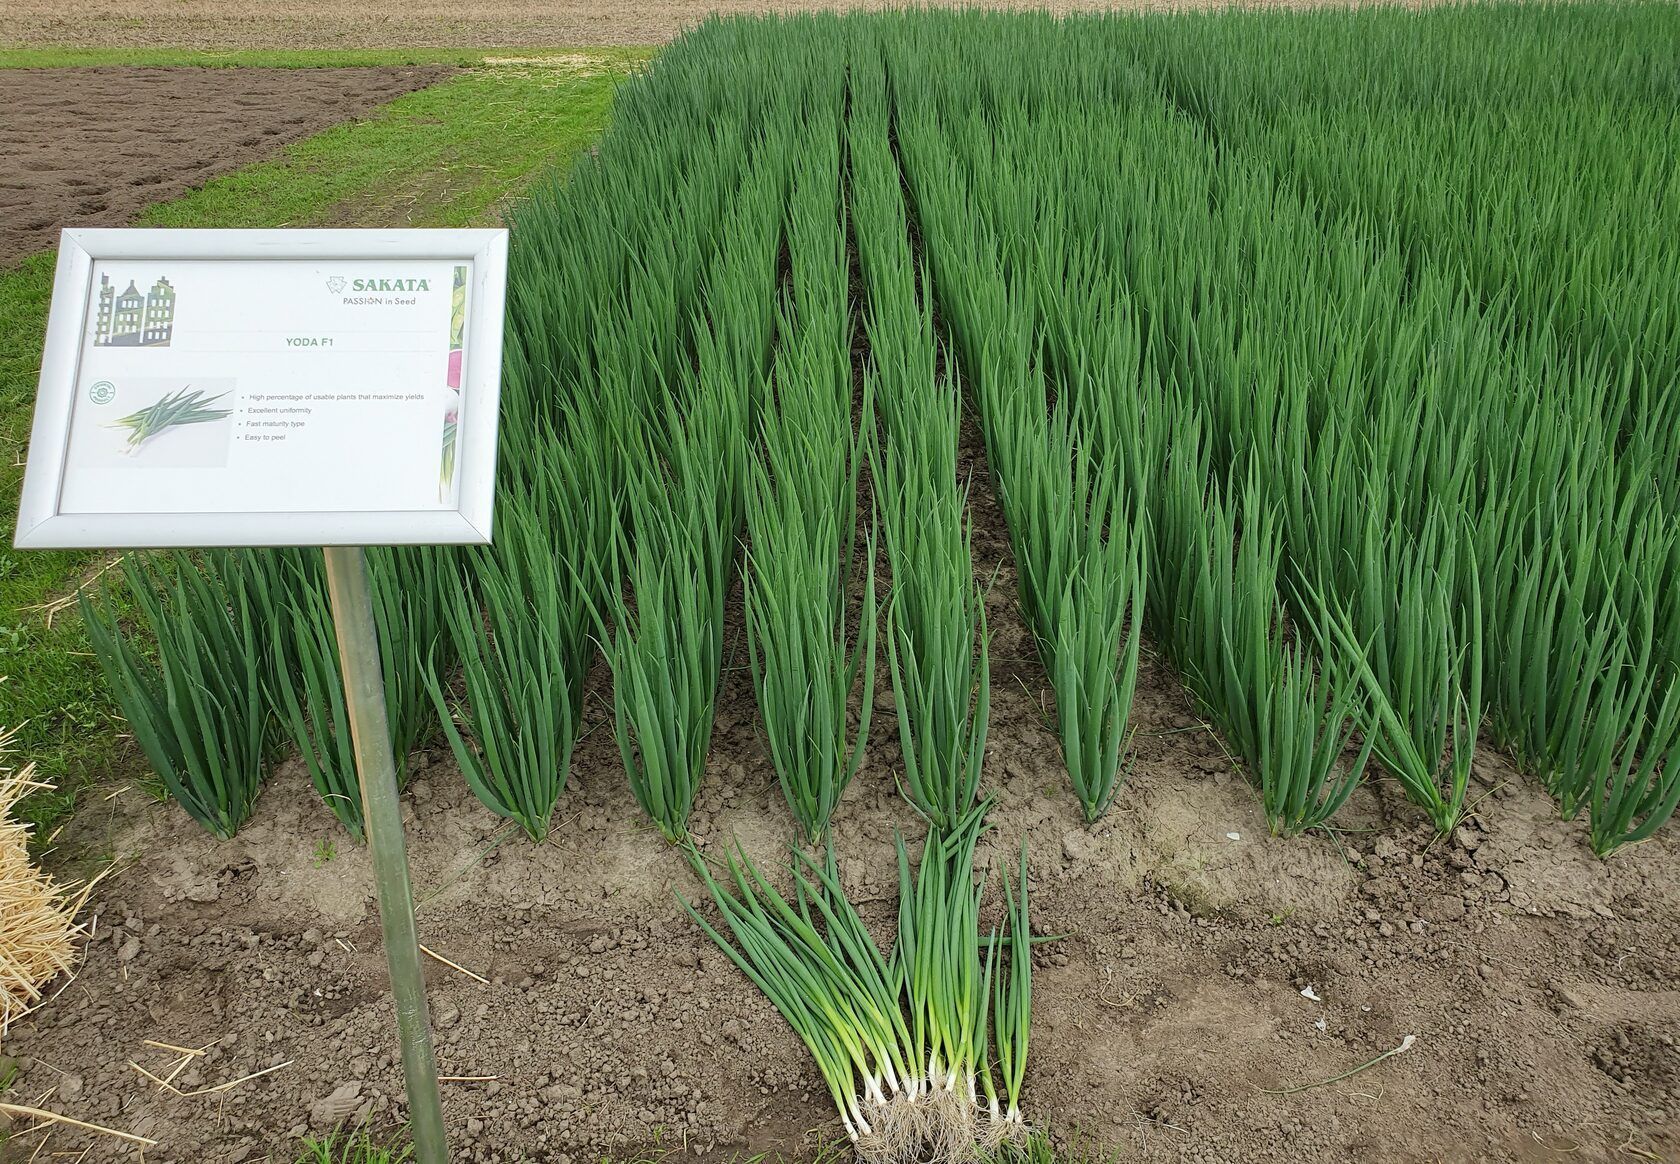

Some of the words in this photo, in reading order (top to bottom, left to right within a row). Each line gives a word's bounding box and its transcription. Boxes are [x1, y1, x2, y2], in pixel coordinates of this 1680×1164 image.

[343, 297, 382, 305] PASSION
[385, 297, 393, 305] in
[394, 297, 416, 305] Seed
[286, 338, 318, 347] YODA
[321, 338, 334, 347] F1
[262, 420, 289, 428] maturity
[290, 420, 305, 428] type
